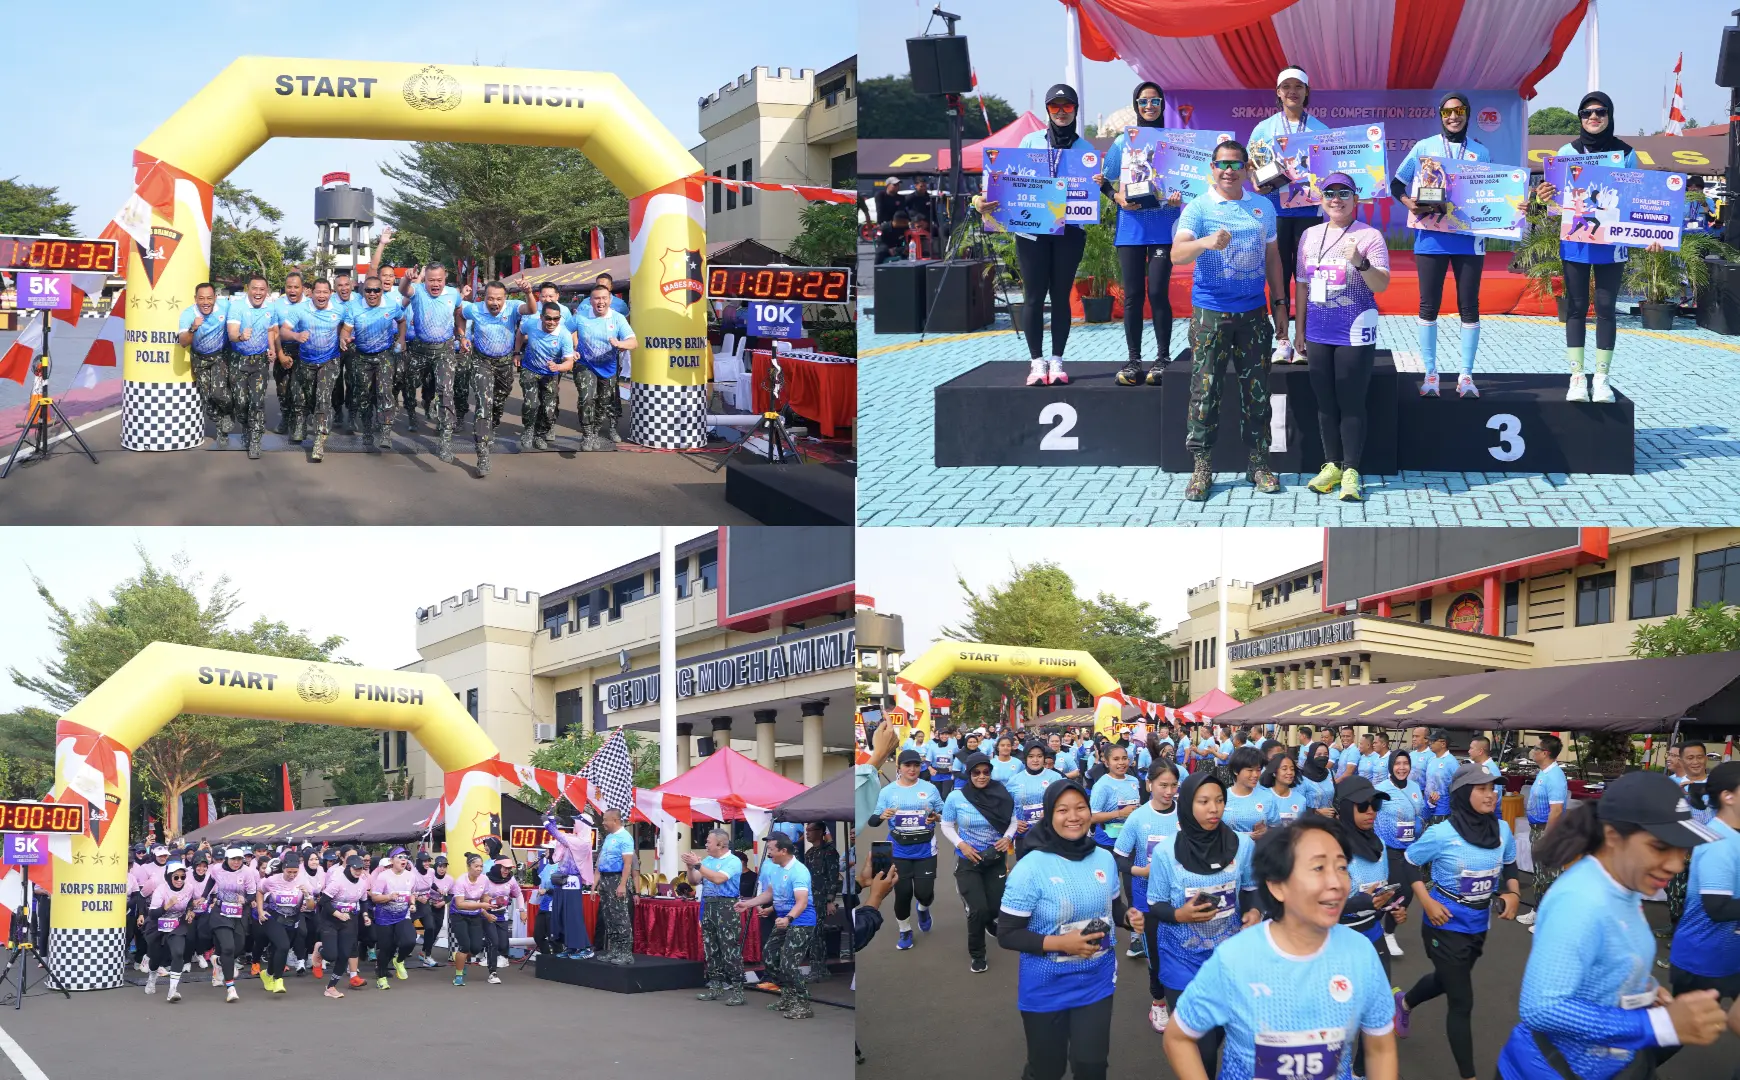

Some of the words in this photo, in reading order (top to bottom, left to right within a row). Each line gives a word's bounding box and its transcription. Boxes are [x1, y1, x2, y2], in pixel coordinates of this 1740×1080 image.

[274, 74, 378, 99] START
[484, 83, 585, 109] FINISH
[1331, 106, 1404, 118] COMPETITION
[1407, 106, 1436, 118] 2024
[1482, 112, 1498, 122] 76
[888, 154, 932, 167] P
[1180, 163, 1189, 172] 10
[1190, 166, 1199, 174] K
[1009, 219, 1041, 228] Saucony
[1470, 215, 1502, 223] Saucony
[1643, 213, 1668, 221] WINNER
[1610, 226, 1624, 236] RP
[1624, 227, 1674, 240] 7.500.000
[30, 276, 60, 295] 5K
[709, 270, 845, 299] 01:03:22
[755, 305, 795, 324] 10K
[645, 336, 682, 349] KORPS
[136, 350, 170, 363] POLRI
[670, 356, 700, 368] POLRI
[1039, 402, 1079, 450] 2
[1485, 413, 1526, 462] 3
[959, 651, 999, 662] START
[1039, 657, 1077, 666] FINISH
[198, 666, 278, 691] START
[354, 683, 424, 705] FINISH
[607, 668, 694, 711] GEDUG
[1271, 693, 1491, 718] POLISI
[901, 817, 919, 825] 282
[14, 837, 40, 852] 5K
[60, 882, 94, 895] KORPS
[1471, 879, 1492, 892] 210
[81, 901, 113, 912] POLRI
[1276, 1052, 1324, 1076] 215
